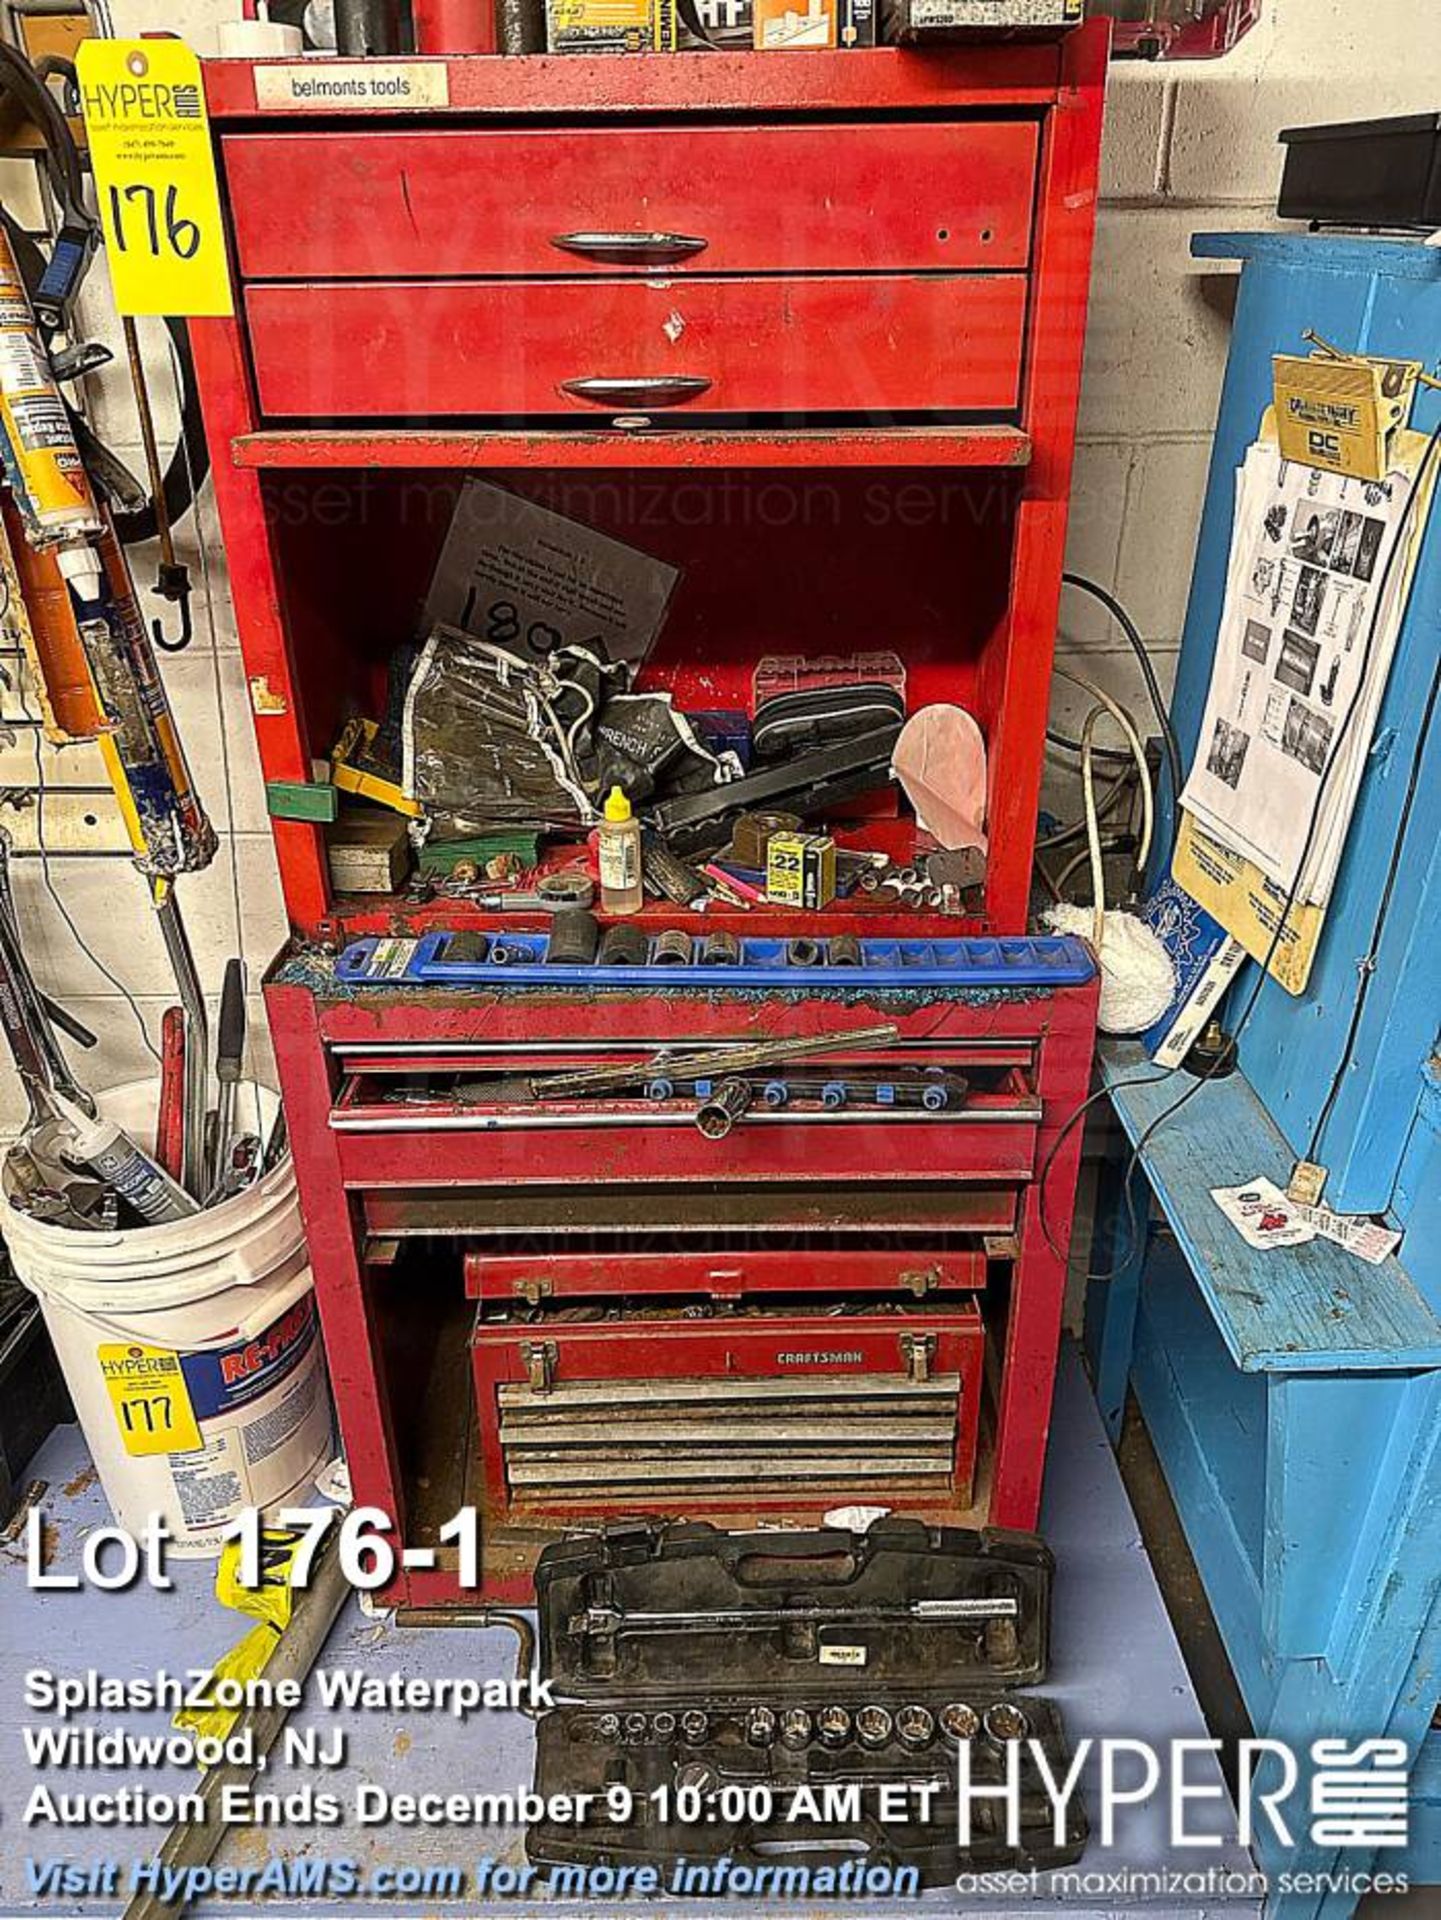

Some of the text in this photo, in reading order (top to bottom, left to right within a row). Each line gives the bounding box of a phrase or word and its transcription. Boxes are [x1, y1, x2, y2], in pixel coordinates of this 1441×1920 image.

[292, 77, 411, 97] belmonts tools
[84, 84, 173, 118] HYPER
[110, 185, 201, 259] 176
[1309, 431, 1339, 451] DC
[775, 855, 800, 871] 22
[101, 1359, 159, 1374] HYPER
[777, 1352, 862, 1365] CRAFTSMAN
[121, 1397, 172, 1432] 177
